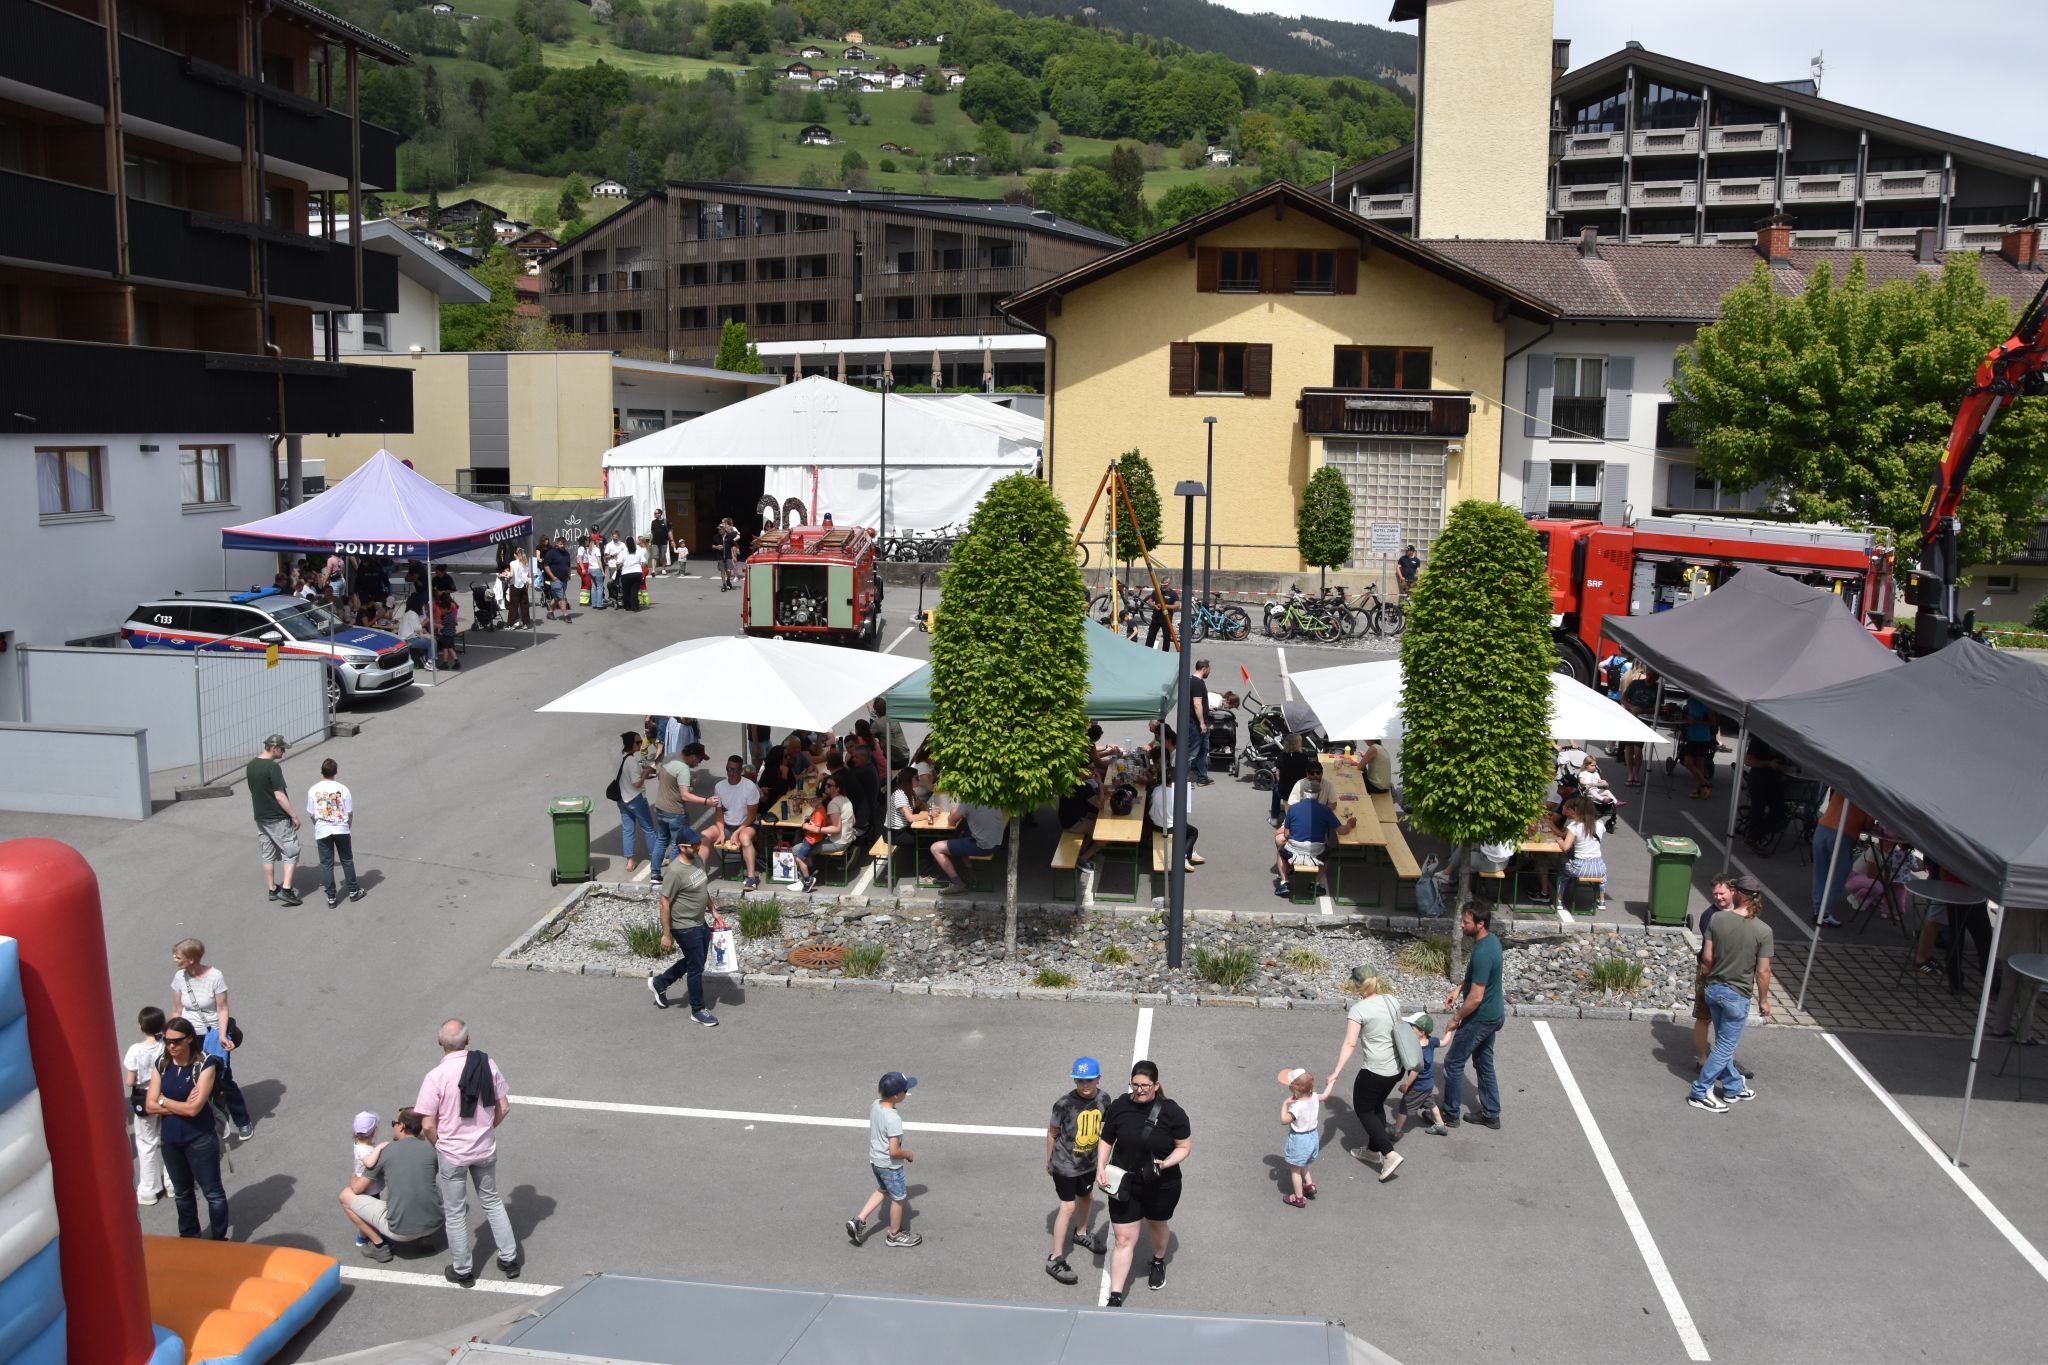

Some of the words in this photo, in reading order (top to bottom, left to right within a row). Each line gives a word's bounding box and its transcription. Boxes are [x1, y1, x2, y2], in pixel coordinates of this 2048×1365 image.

[489, 526, 522, 543] POLIZEI
[334, 542, 403, 556] POLIZEI
[1586, 579, 1603, 588] SRF
[160, 615, 173, 625] 133
